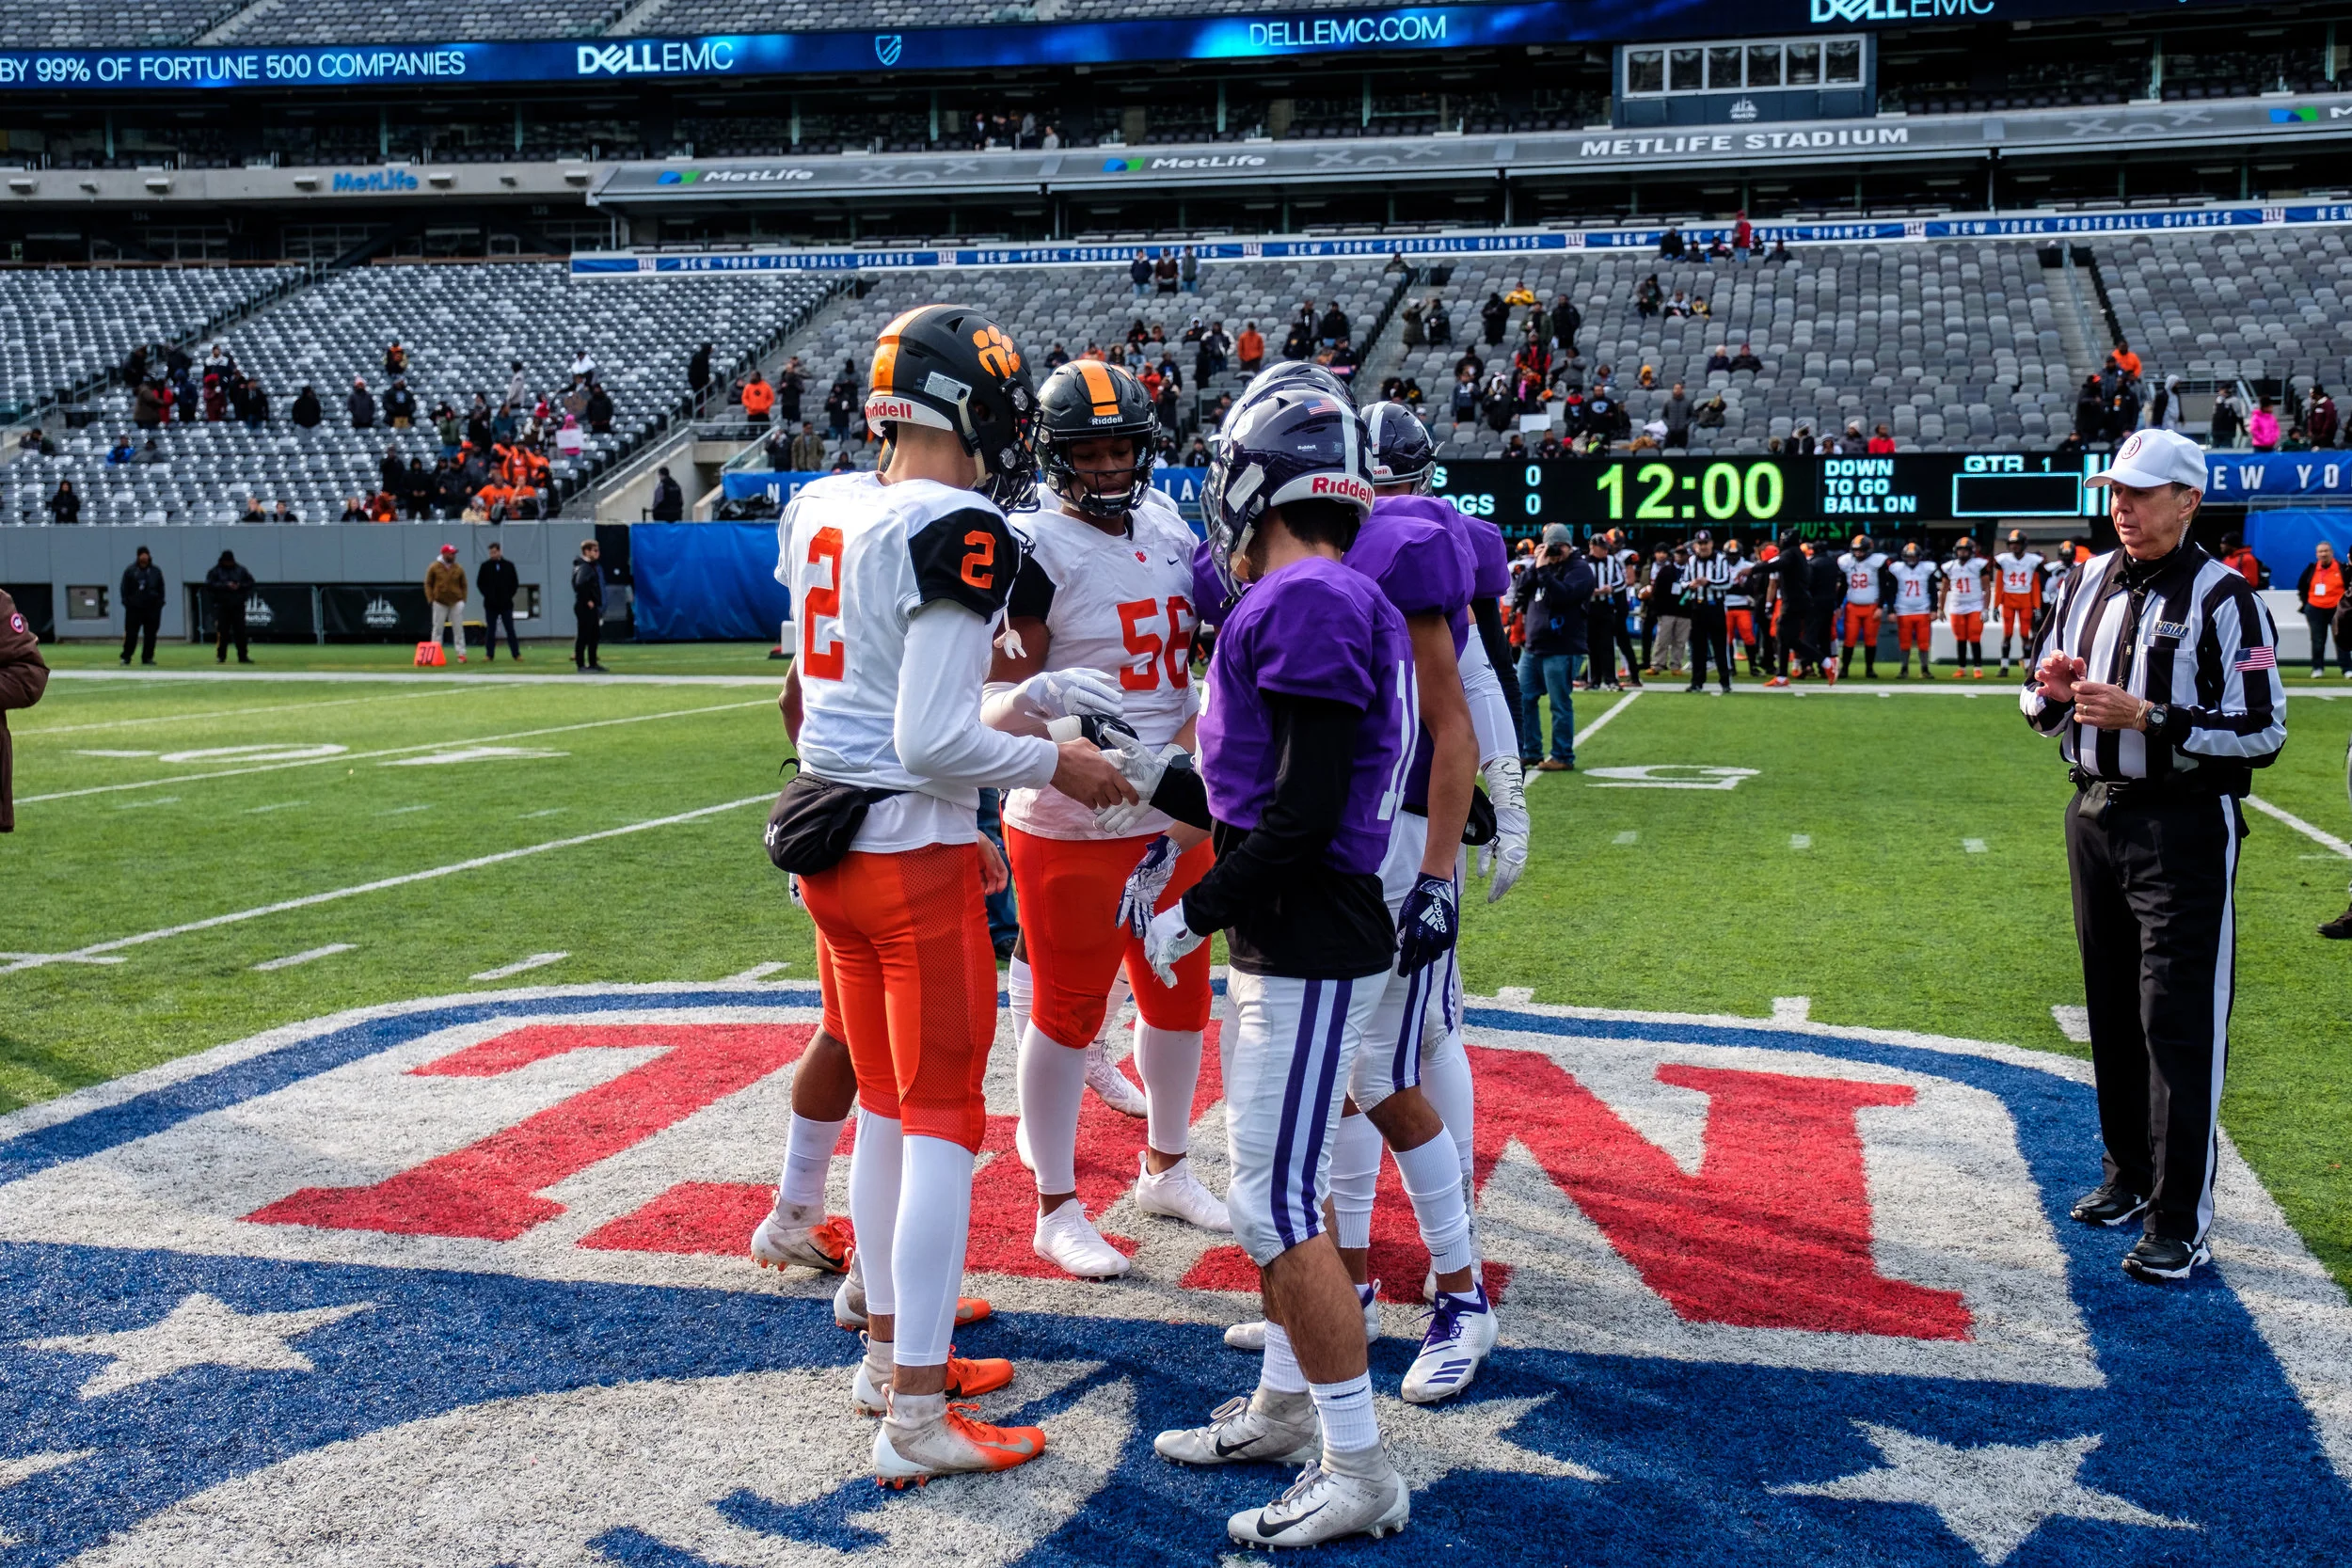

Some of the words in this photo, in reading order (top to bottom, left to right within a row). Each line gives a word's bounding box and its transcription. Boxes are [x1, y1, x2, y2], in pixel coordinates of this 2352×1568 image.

[1249, 15, 1446, 46] DELLEMC.COM
[0, 57, 29, 82] BY
[36, 56, 90, 82] 99%
[97, 56, 132, 82] OF
[139, 55, 260, 81] FORTUNE
[266, 53, 311, 79] 500
[318, 51, 466, 78] COMPANIES
[1581, 135, 1732, 156] METLIFE
[1745, 128, 1908, 150] STADIUM
[1151, 154, 1266, 169] MetLife
[332, 169, 419, 193] MetLife
[704, 169, 814, 182] MetLife
[1948, 221, 1986, 235] NEW
[1999, 219, 2044, 233] YORK
[2057, 215, 2150, 231] FOOTBALL
[2163, 212, 2233, 227] GIANTS
[1612, 233, 1647, 245] NEW
[1812, 226, 1877, 240] GIANTS
[1288, 243, 1322, 255] NEW
[1332, 241, 1374, 254] YORK
[1384, 238, 1468, 252] FOOTBALL
[1478, 236, 1540, 250] GIANTS
[679, 258, 712, 271] NEW
[721, 256, 760, 270] YORK
[771, 253, 848, 268] FOOTBALL
[857, 253, 914, 266] GIANTS
[977, 251, 1009, 264] NEW
[1021, 249, 1060, 262] YORK
[1091, 416, 1123, 425] Riddell
[1824, 459, 1894, 477] DOWN
[1964, 455, 2025, 472] QTR
[2042, 457, 2052, 472] 1
[1525, 465, 1542, 487] 0
[2213, 465, 2265, 491] EW
[2296, 464, 2352, 489] YO
[1311, 477, 1374, 507] Riddell
[1597, 462, 1784, 519] 12:00
[1824, 479, 1853, 496] TO
[1858, 479, 1890, 496] GO
[1525, 493, 1542, 516] 0
[1823, 497, 1880, 515] BALL
[1884, 496, 1917, 514] ON
[961, 530, 996, 590] 2
[1851, 573, 1867, 589] 62
[1905, 579, 1920, 597] 71
[1955, 577, 1971, 594] 41
[803, 527, 844, 682] 2
[1117, 595, 1194, 691] 56
[417, 646, 436, 665] 30
[1433, 896, 1447, 933] adidas
